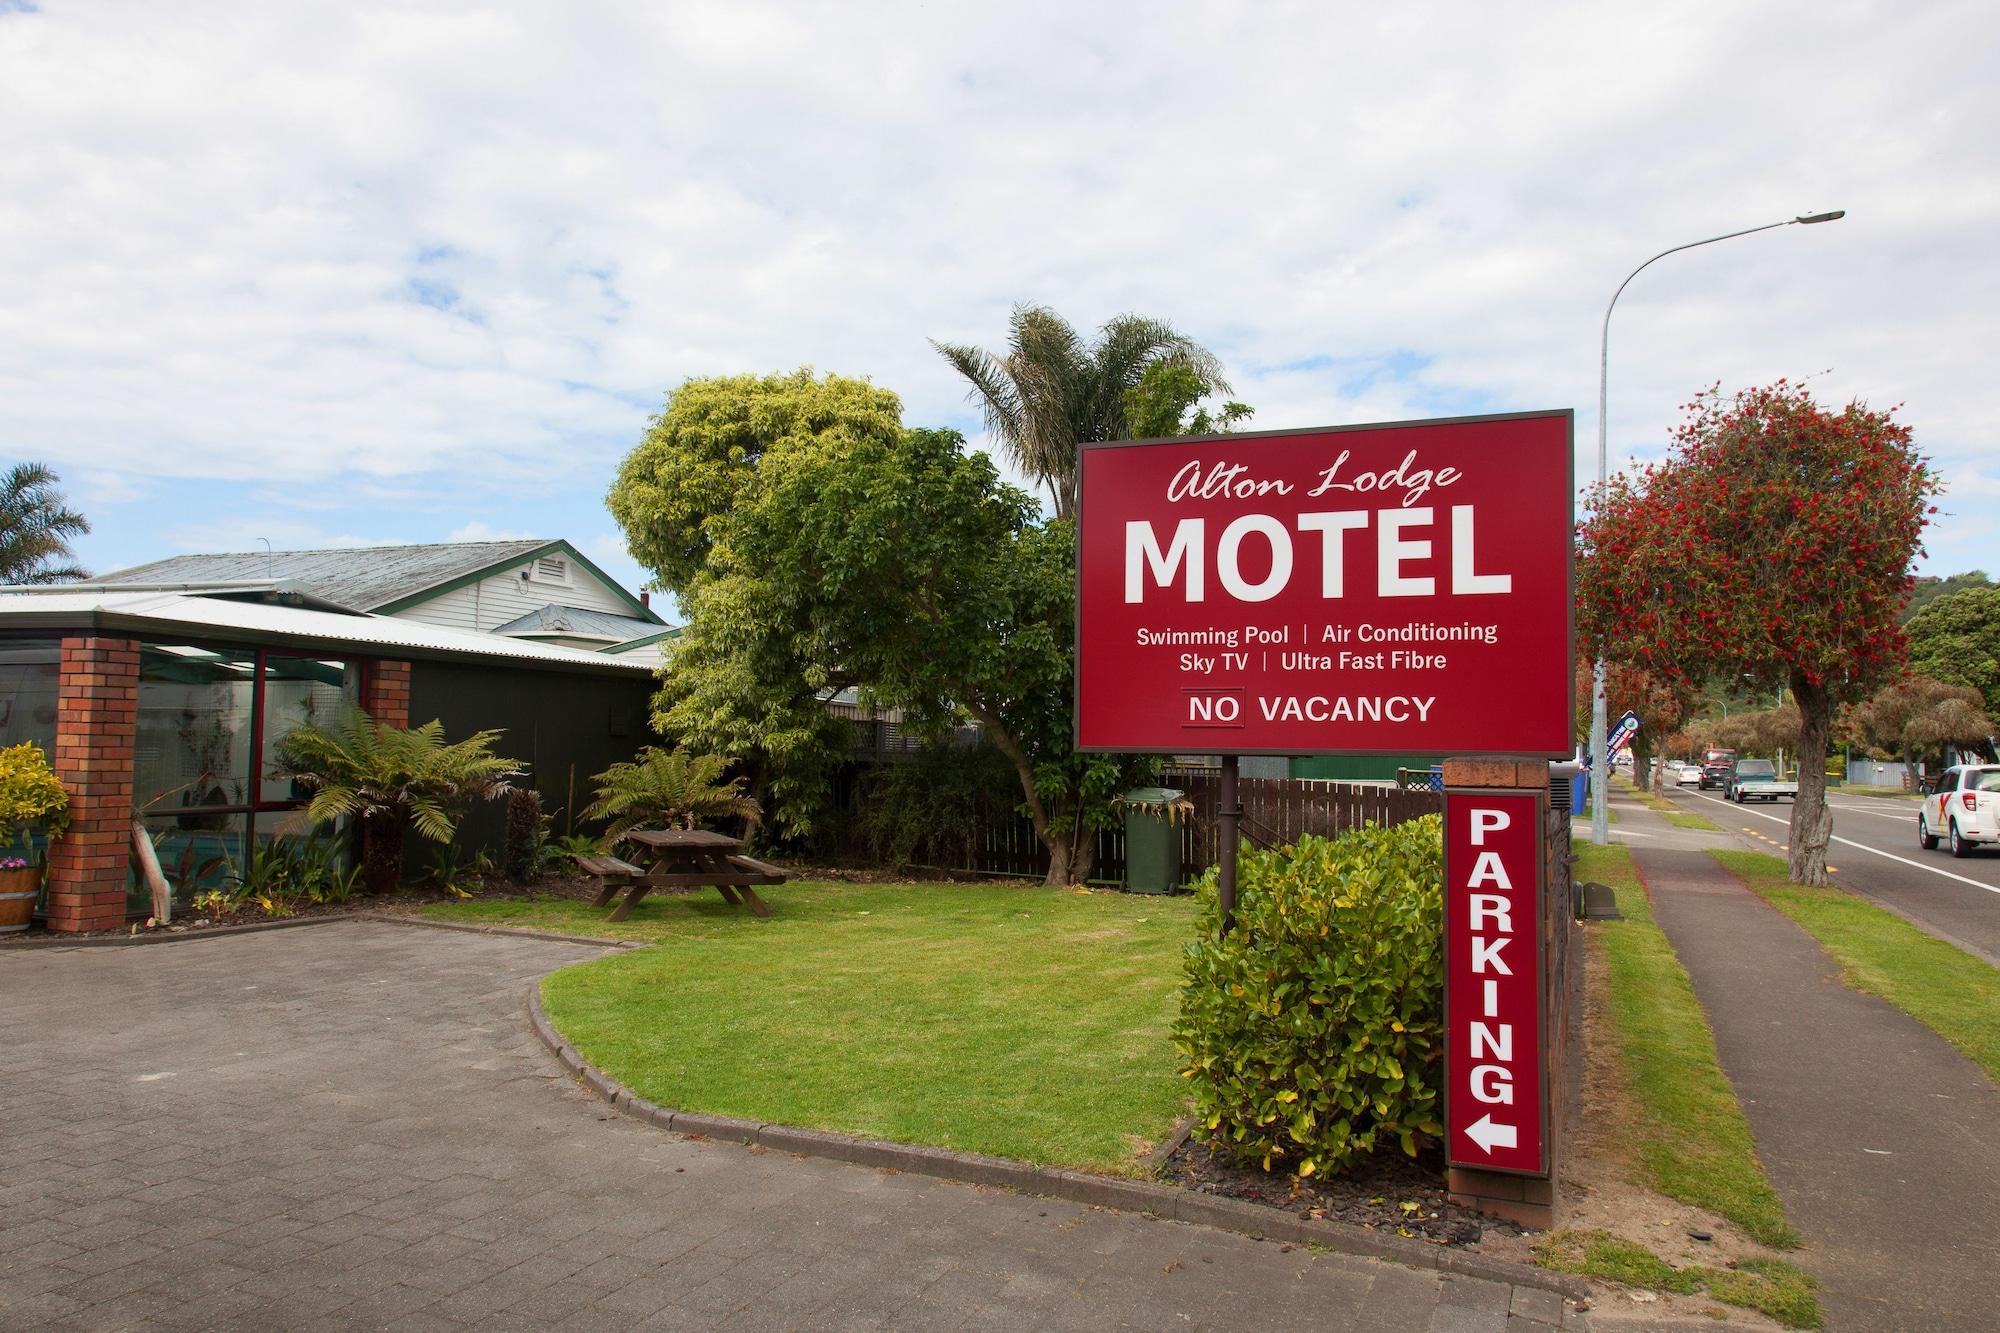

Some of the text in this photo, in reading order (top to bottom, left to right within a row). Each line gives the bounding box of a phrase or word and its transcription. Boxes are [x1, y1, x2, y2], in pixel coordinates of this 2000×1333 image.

[1166, 449, 1463, 508] Alton Lodge
[1125, 504, 1512, 603] MOTEL
[1136, 626, 1289, 648] Swimming Pool
[1322, 622, 1498, 644] Air Conditioning
[1180, 653, 1249, 675] Sky TV
[1282, 651, 1447, 671] Ultra Fast Fibre
[1188, 696, 1436, 722] NO VACANCY
[1467, 809, 1514, 1105] PARKING
